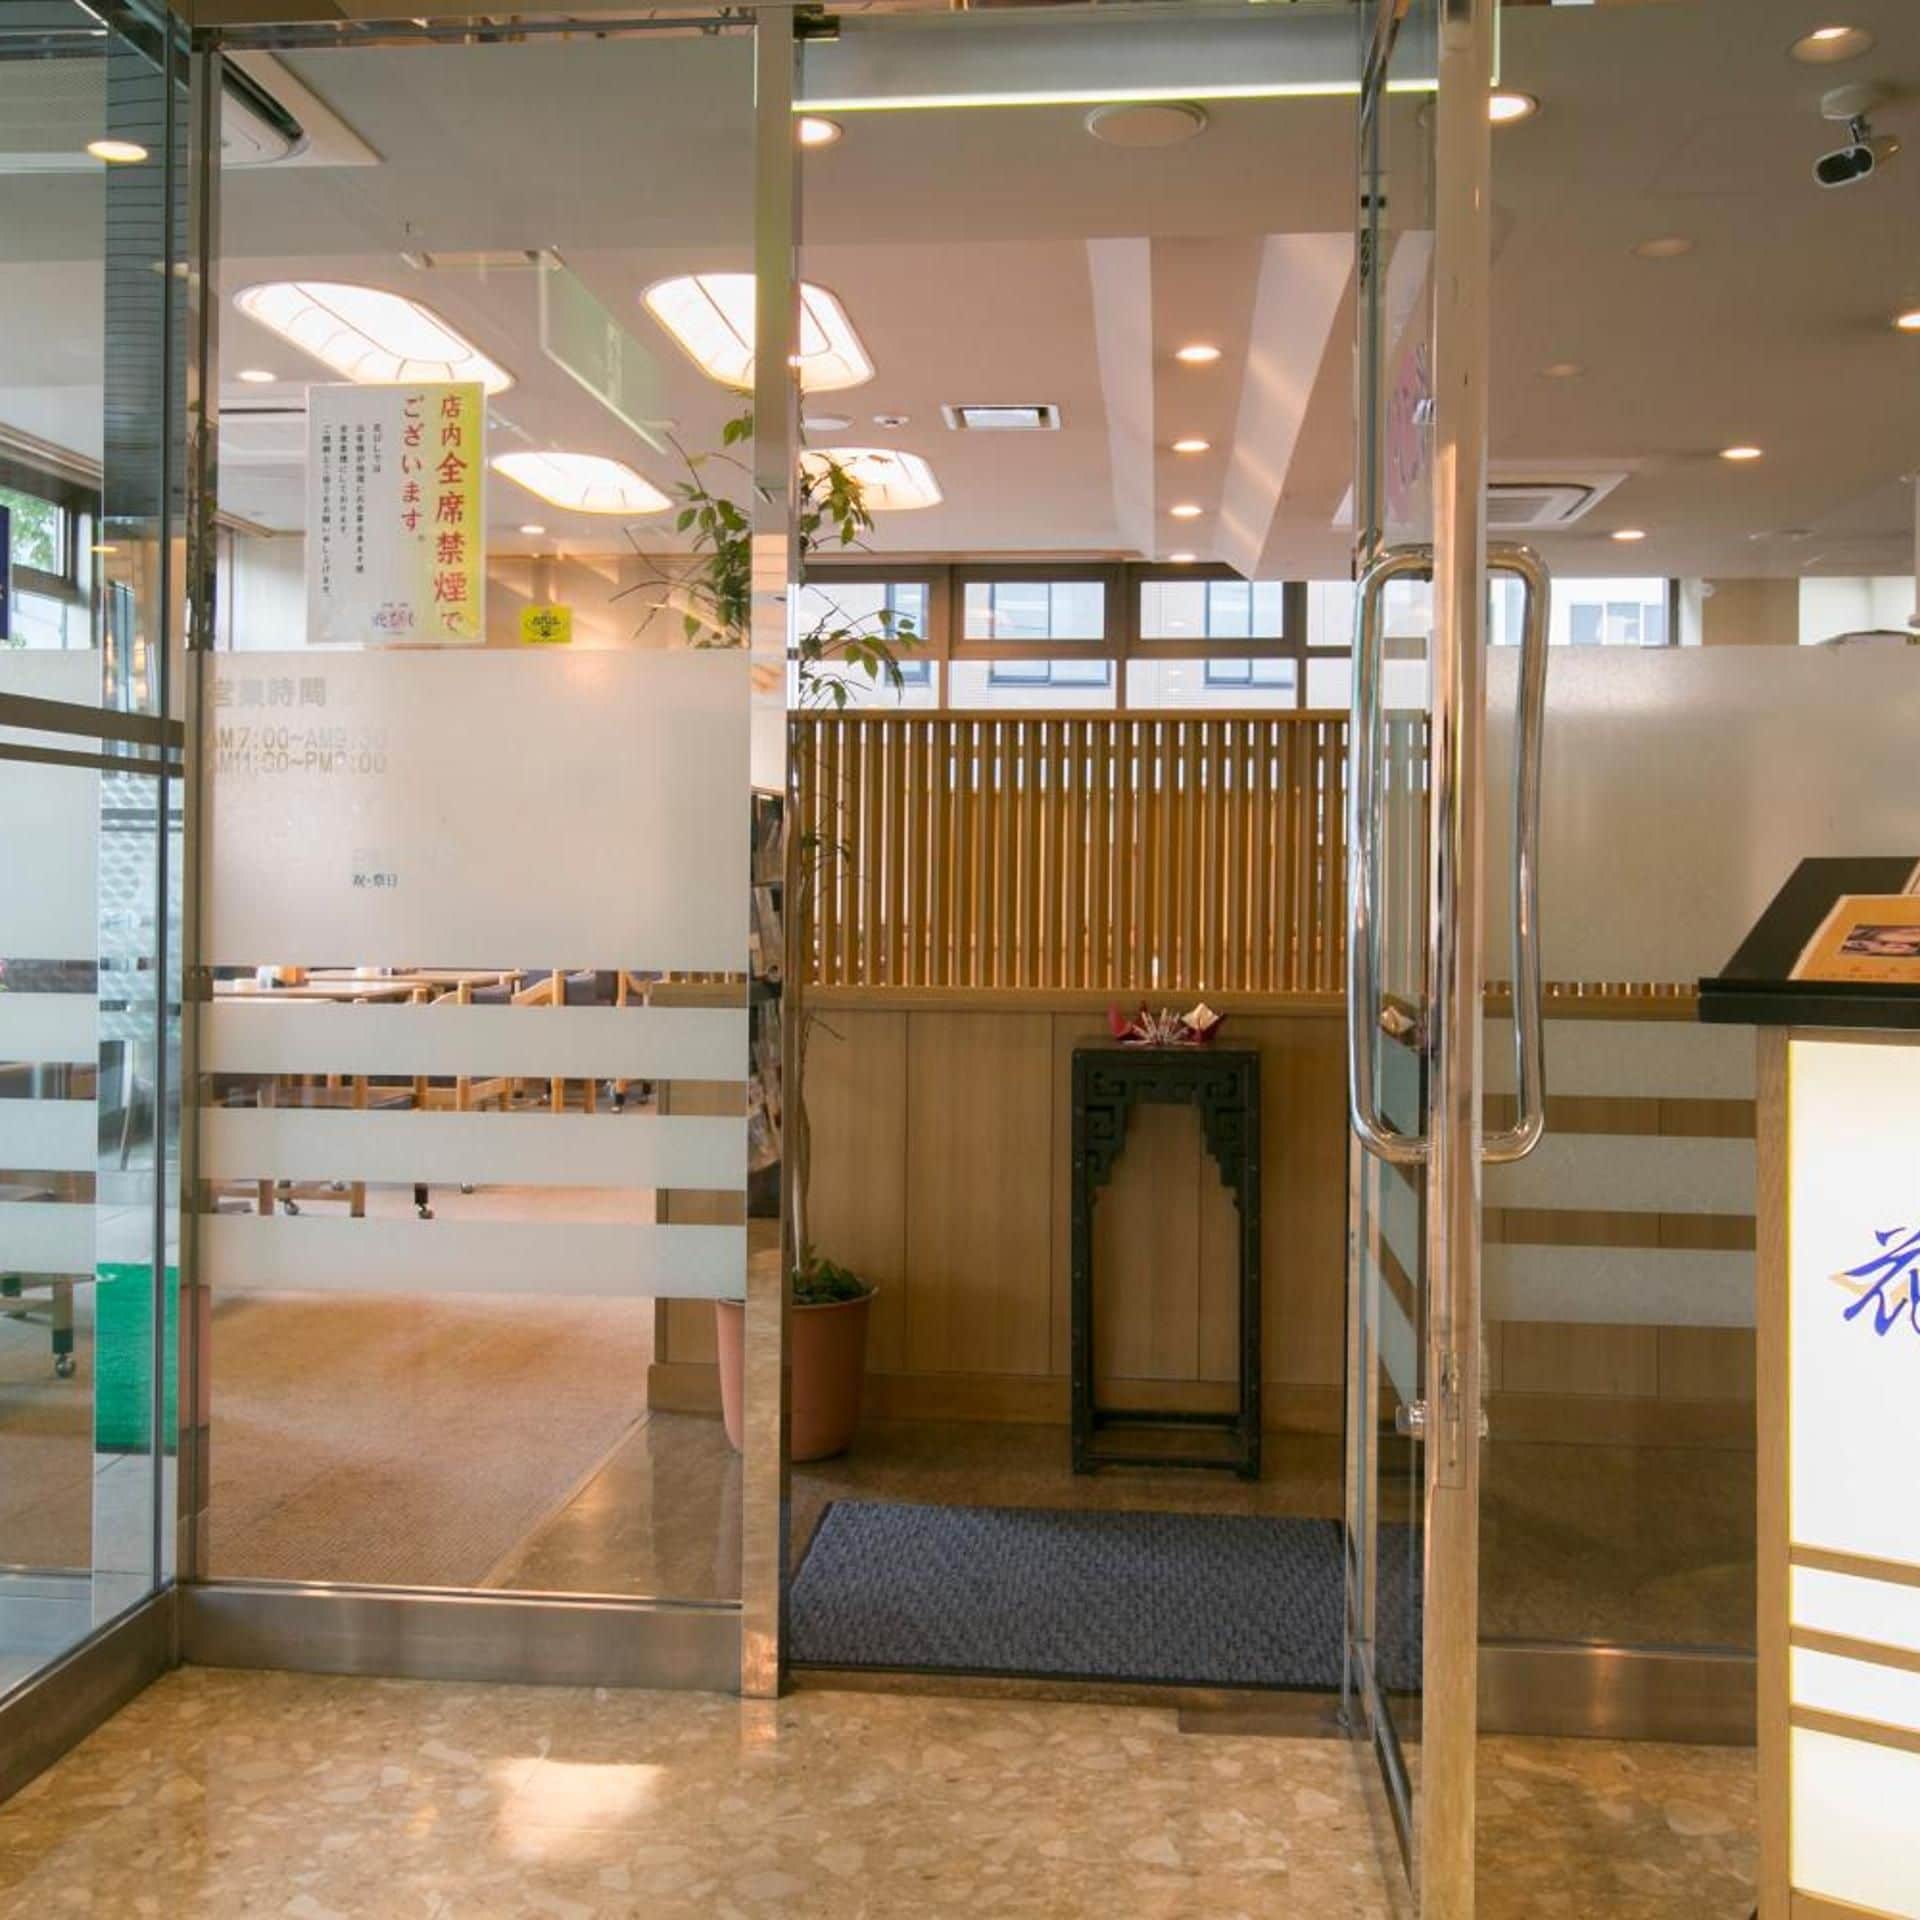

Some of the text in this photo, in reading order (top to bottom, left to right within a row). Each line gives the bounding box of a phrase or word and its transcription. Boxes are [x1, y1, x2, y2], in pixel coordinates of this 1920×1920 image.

[400, 394, 425, 543] ございます。
[433, 394, 468, 633] 店内全席禁煙で
